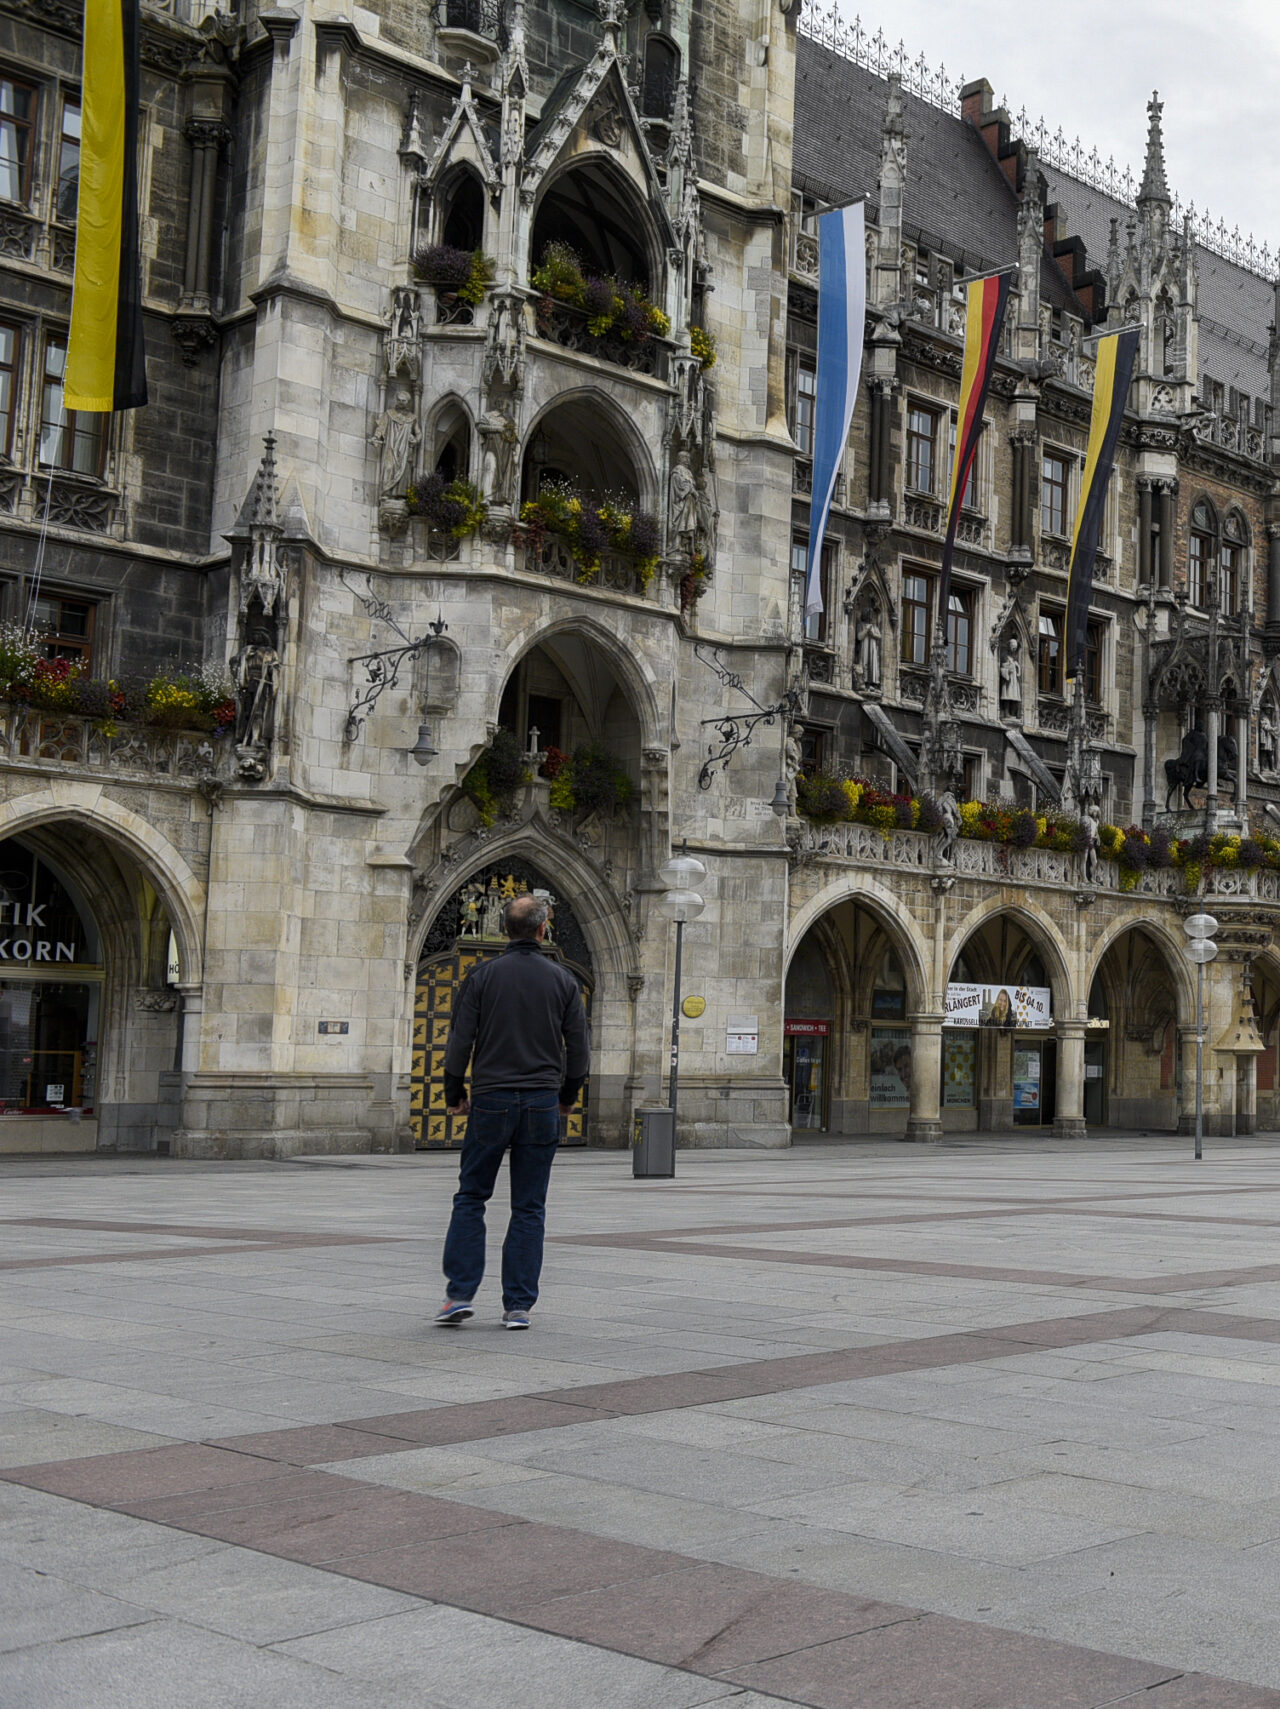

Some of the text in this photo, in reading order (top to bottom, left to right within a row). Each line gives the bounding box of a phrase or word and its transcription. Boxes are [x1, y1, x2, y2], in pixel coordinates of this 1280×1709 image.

[0, 939, 75, 962] KORN
[1014, 989, 1025, 1004] BIS
[790, 1024, 827, 1032] SANDWICH TEE
[871, 1083, 896, 1092] einfach
